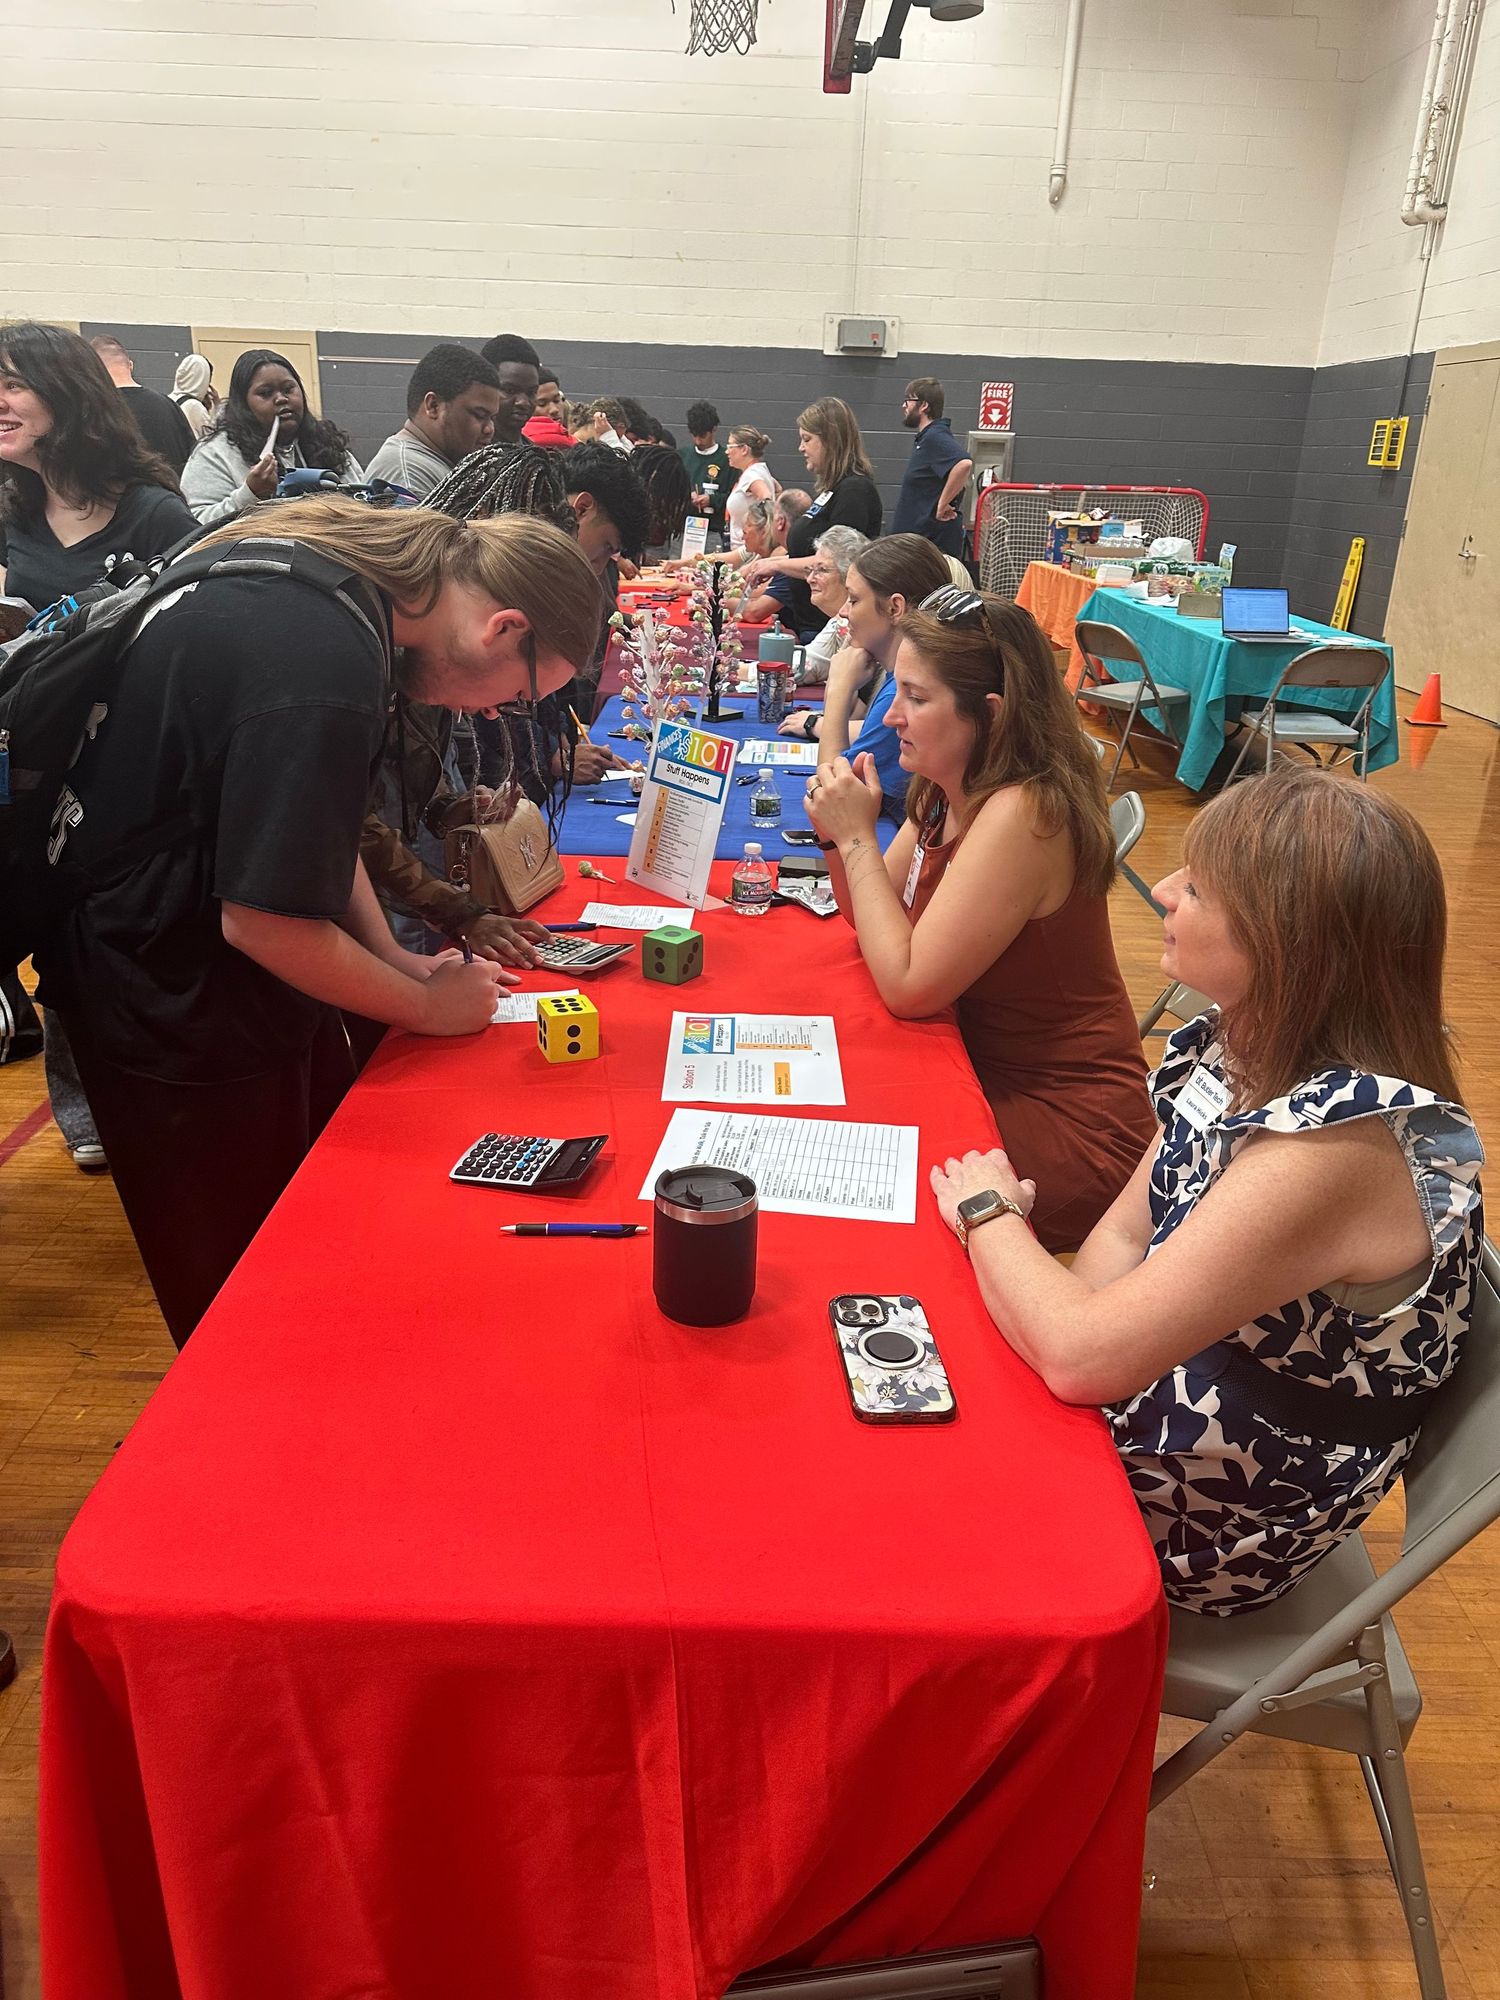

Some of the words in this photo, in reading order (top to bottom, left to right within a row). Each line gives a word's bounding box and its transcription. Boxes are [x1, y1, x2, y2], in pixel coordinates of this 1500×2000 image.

[987, 388, 1009, 398] FIRE
[657, 727, 682, 754] FINANCES
[666, 763, 681, 776] Stuff
[681, 768, 710, 786] Happens
[682, 1069, 695, 1089] Station
[1200, 1081, 1215, 1097] Butler
[1212, 1091, 1224, 1106] Tech
[1186, 1097, 1198, 1111] Laura
[1196, 1107, 1208, 1120] Hicks
